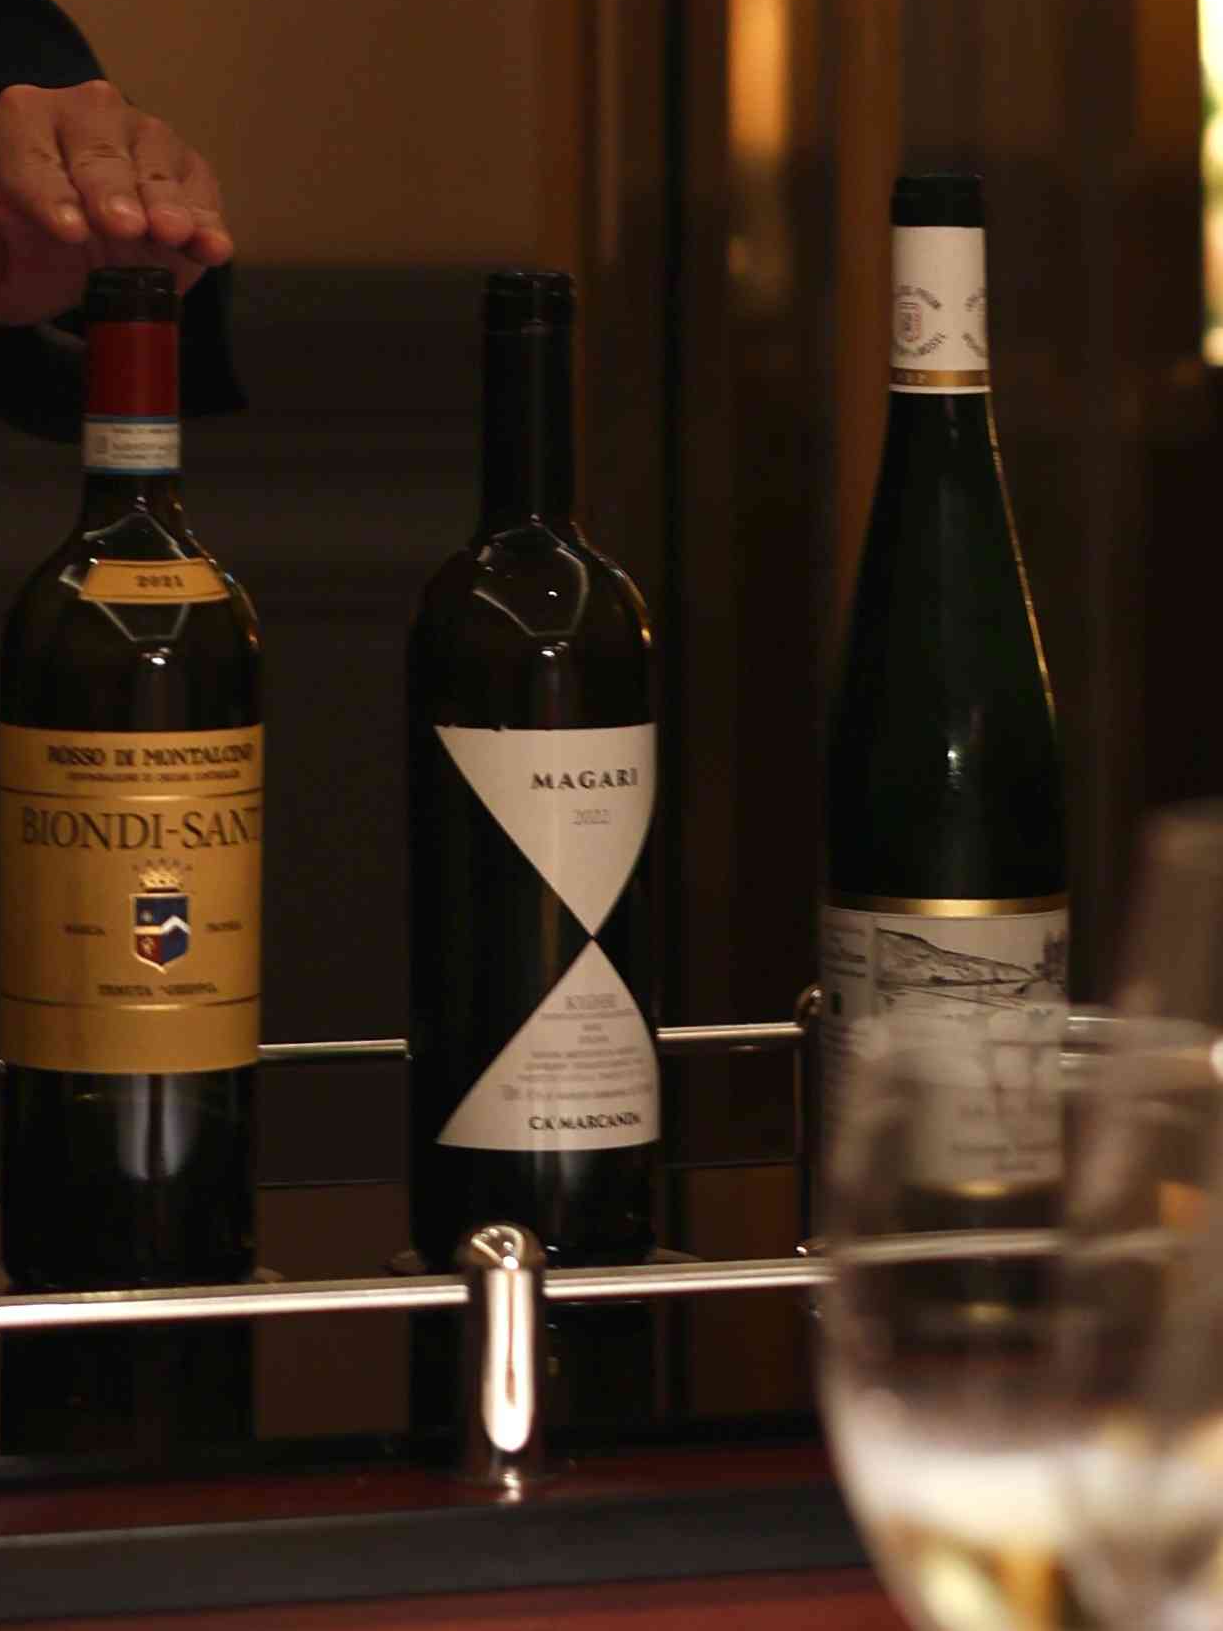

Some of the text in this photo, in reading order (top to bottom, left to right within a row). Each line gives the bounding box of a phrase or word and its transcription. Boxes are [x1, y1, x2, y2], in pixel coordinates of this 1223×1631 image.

[48, 744, 106, 767] ROSSO
[113, 748, 136, 767] DI
[530, 767, 638, 790] MAGARI
